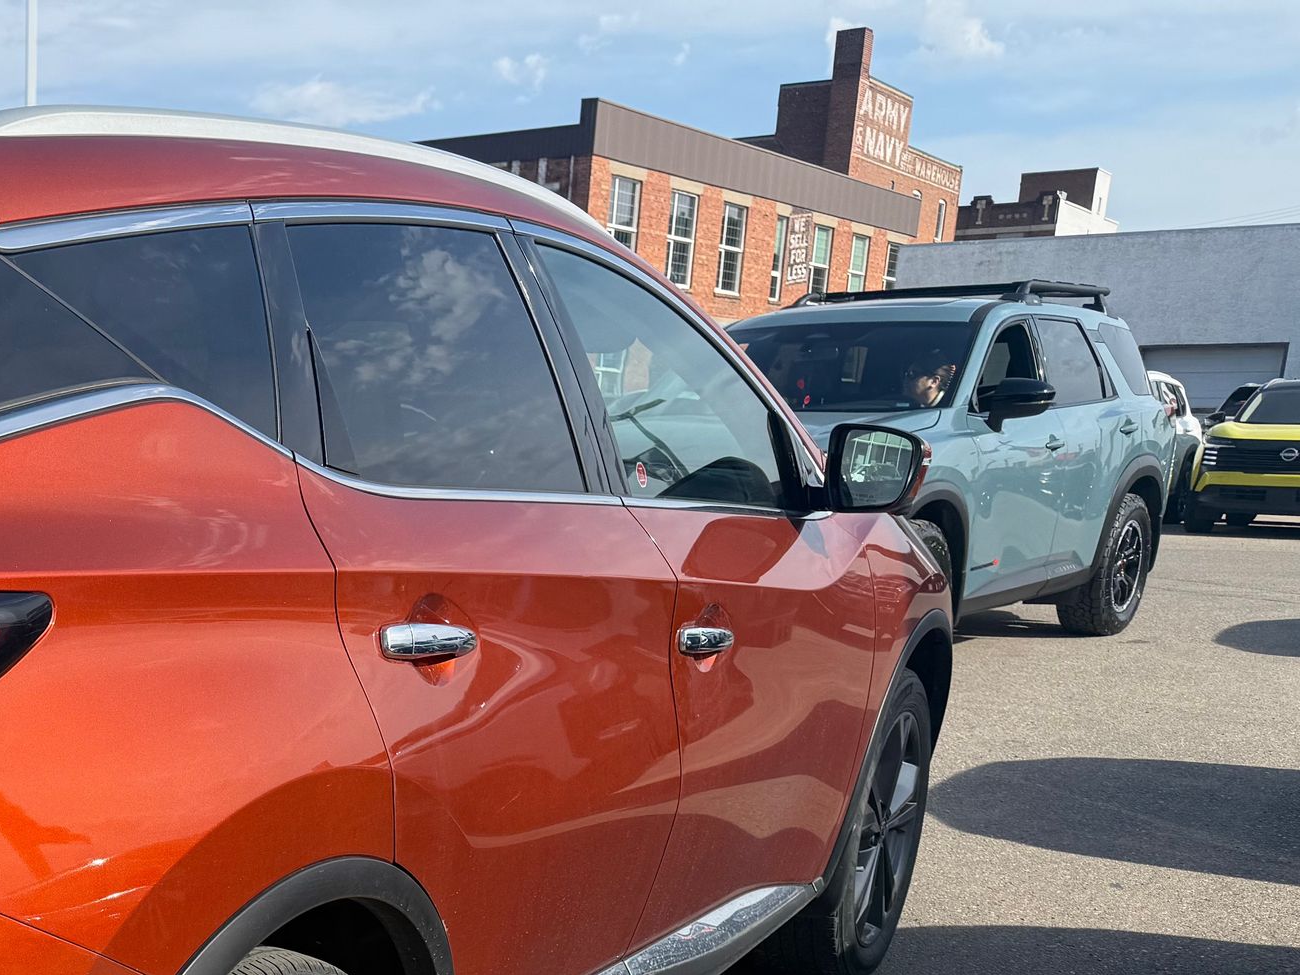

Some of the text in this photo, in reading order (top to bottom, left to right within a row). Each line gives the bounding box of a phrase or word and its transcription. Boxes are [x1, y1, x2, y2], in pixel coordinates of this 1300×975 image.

[860, 88, 910, 133] ARMY
[863, 125, 905, 167] NAVY
[915, 157, 960, 190] WAREHOUSE
[794, 217, 806, 233] WE
[789, 234, 808, 249] SELL
[790, 249, 806, 265] FOR
[787, 264, 807, 281] LESS
